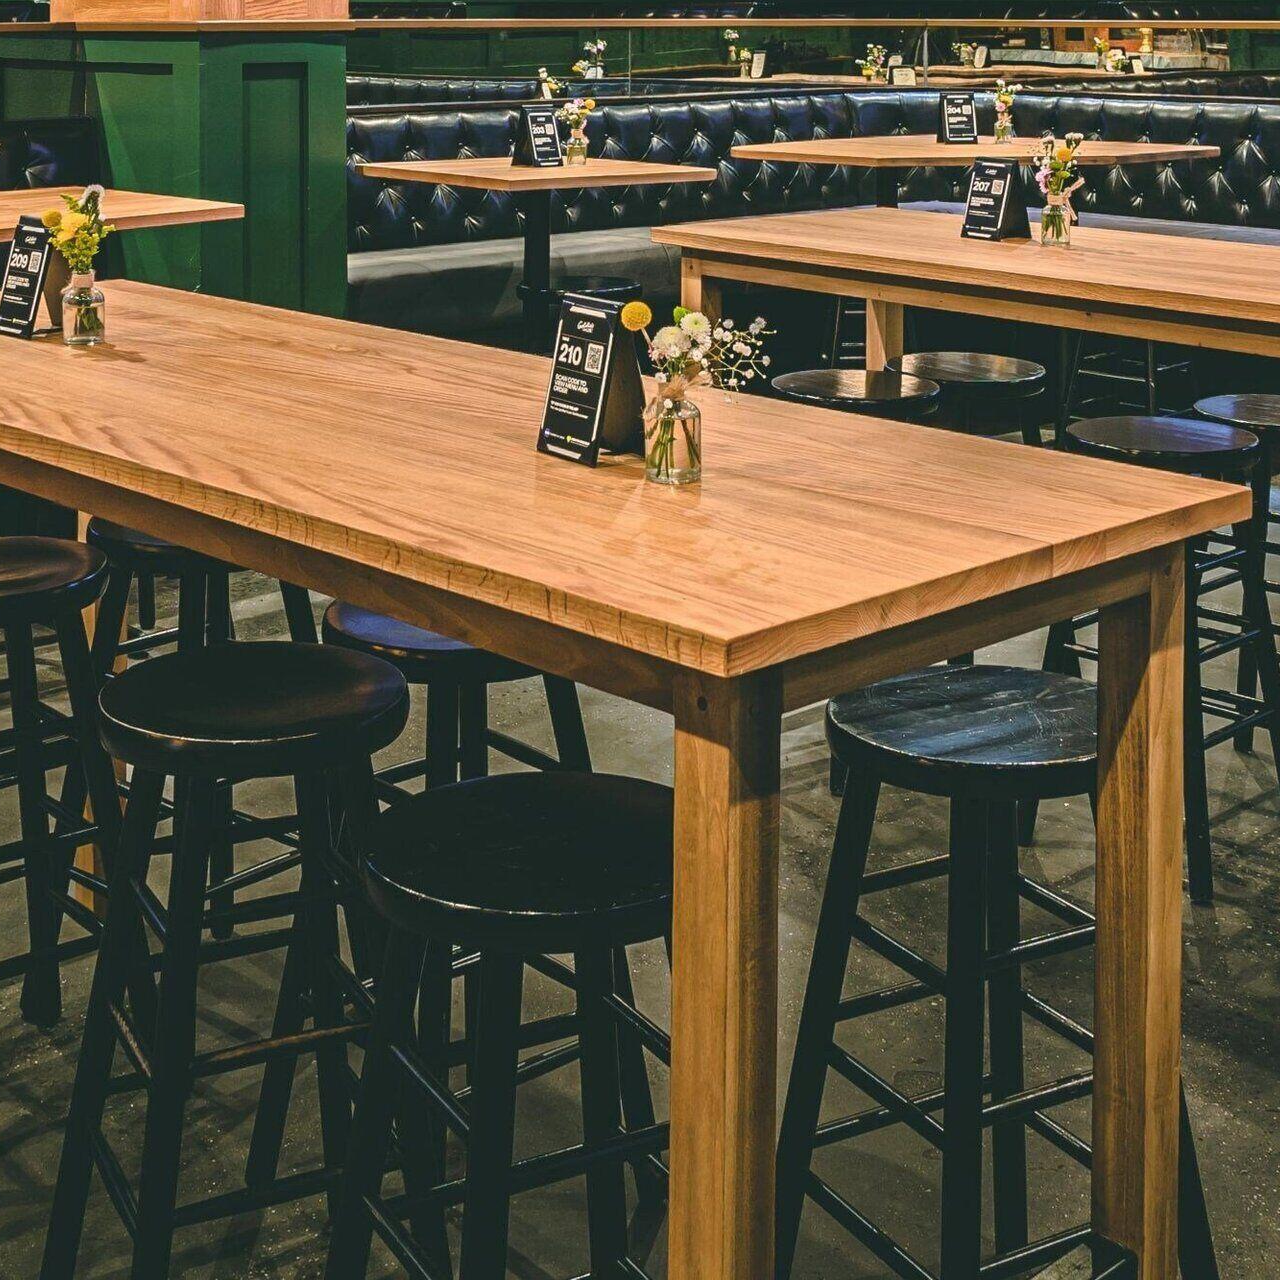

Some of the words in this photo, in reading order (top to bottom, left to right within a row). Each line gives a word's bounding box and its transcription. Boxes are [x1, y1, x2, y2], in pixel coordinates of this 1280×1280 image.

[972, 181, 991, 192] 207
[10, 252, 29, 269] 209
[558, 343, 583, 366] 210
